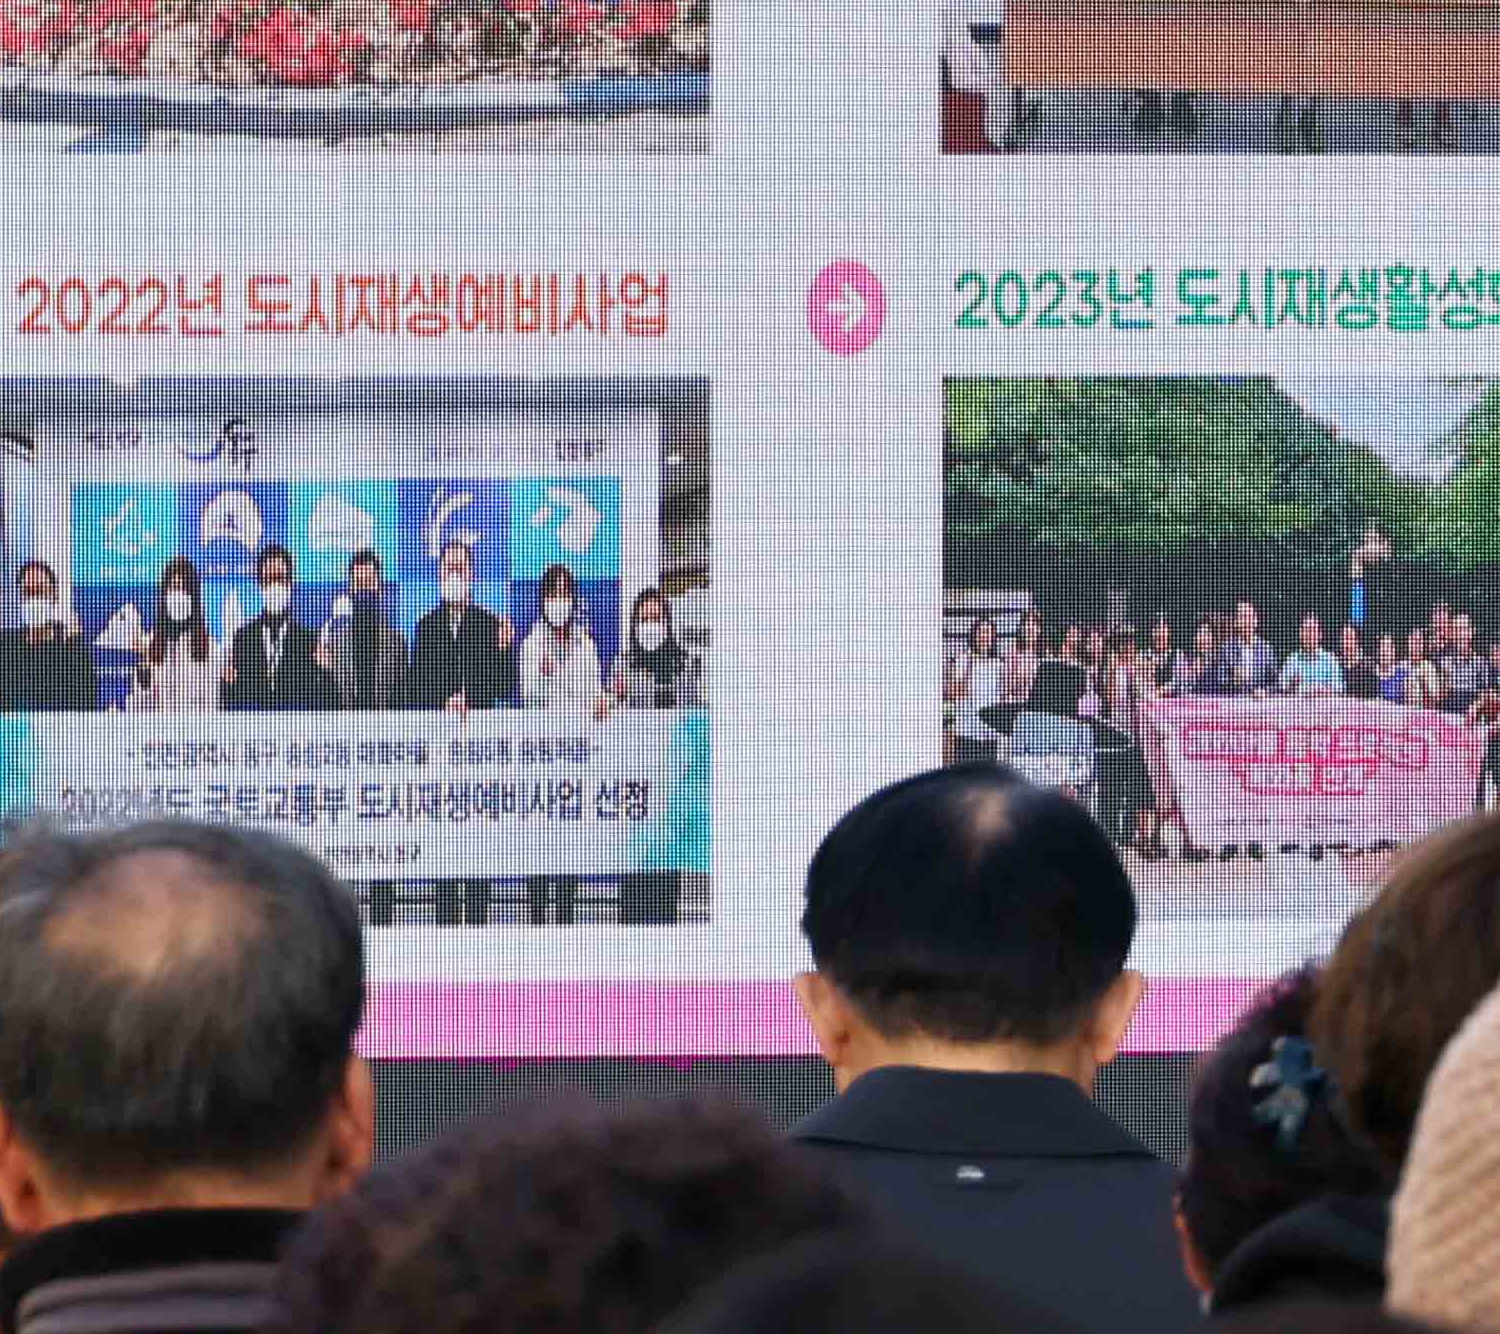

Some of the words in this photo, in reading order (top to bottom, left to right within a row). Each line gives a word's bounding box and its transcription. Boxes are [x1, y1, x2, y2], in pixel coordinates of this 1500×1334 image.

[15, 276, 227, 337] 2022년
[244, 271, 669, 339] 도시재생예비사업
[954, 267, 1155, 332] 2023년
[595, 780, 650, 821] 선정
